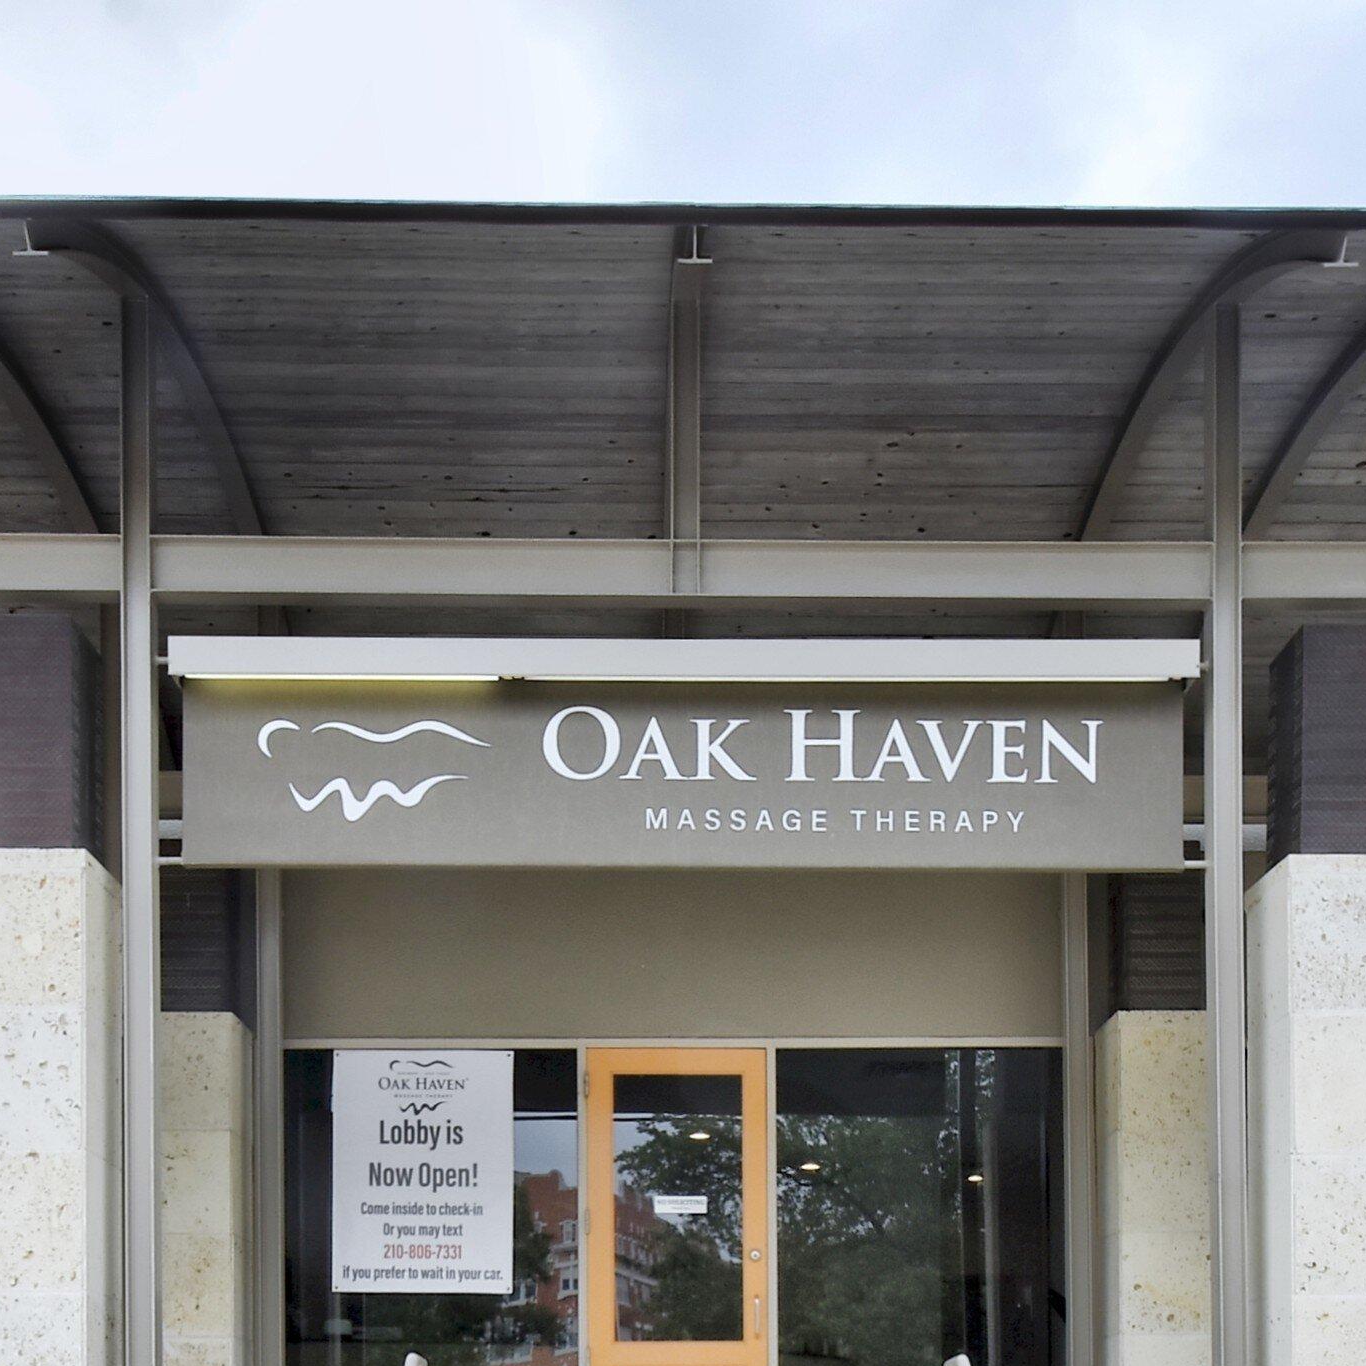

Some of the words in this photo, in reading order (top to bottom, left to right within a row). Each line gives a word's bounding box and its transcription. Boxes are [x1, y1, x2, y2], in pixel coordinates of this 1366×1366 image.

[541, 704, 756, 783] OAK
[783, 708, 1104, 785] HAVEN
[644, 807, 829, 834] MASSAGE
[848, 808, 1026, 834] THERAPY
[378, 1076, 411, 1090] OAK
[415, 1077, 465, 1091] HAVEN
[379, 1119, 441, 1151] Lobby
[446, 1119, 464, 1146] is
[368, 1162, 413, 1187] Now
[419, 1162, 478, 1193] Open!
[360, 1202, 390, 1215] Come
[392, 1202, 424, 1216] inside
[426, 1203, 436, 1216] to
[438, 1202, 483, 1216] check-in
[383, 1223, 395, 1236] Or
[397, 1226, 417, 1240] you
[418, 1226, 441, 1240] may
[443, 1224, 463, 1237] text
[383, 1244, 462, 1260] 210-806-7331
[342, 1265, 350, 1279] if
[352, 1268, 373, 1282] you
[374, 1266, 406, 1282] prefer
[408, 1267, 419, 1280] to
[421, 1267, 444, 1280] wait
[445, 1267, 456, 1280] in
[457, 1270, 482, 1283] your
[484, 1269, 503, 1281] car.
